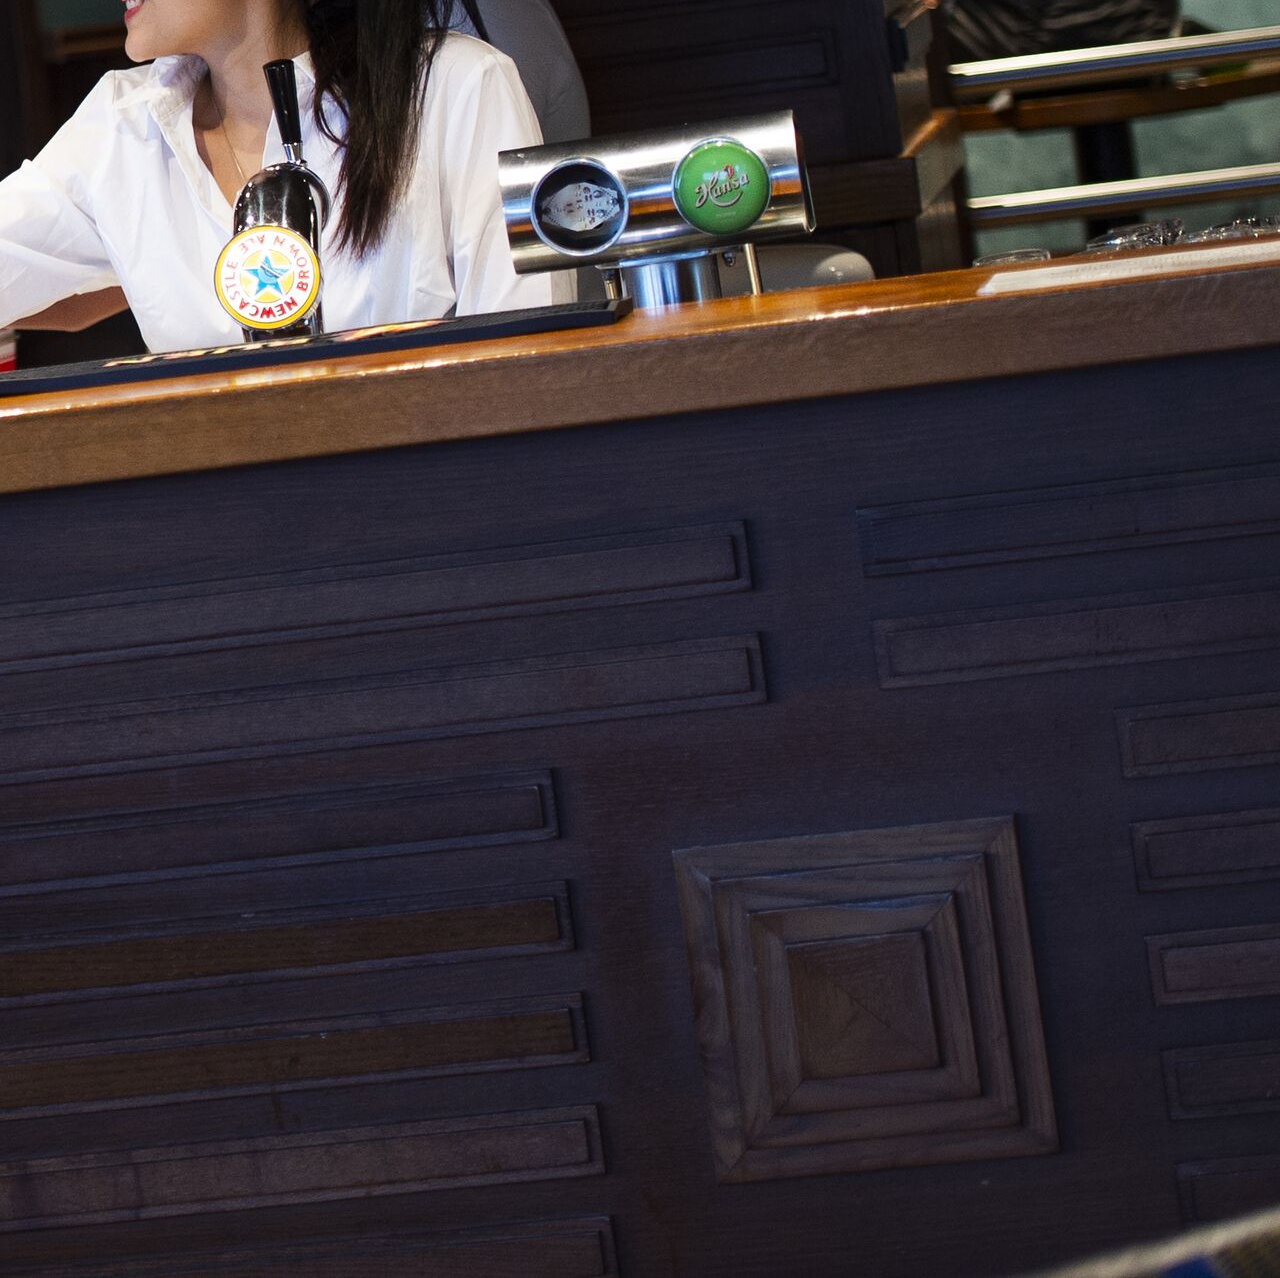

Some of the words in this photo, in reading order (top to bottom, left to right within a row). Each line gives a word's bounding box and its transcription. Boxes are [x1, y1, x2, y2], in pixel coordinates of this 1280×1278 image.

[695, 170, 749, 208] Hansa
[224, 259, 299, 319] NEWCASTLE
[273, 234, 310, 292] BROWN
